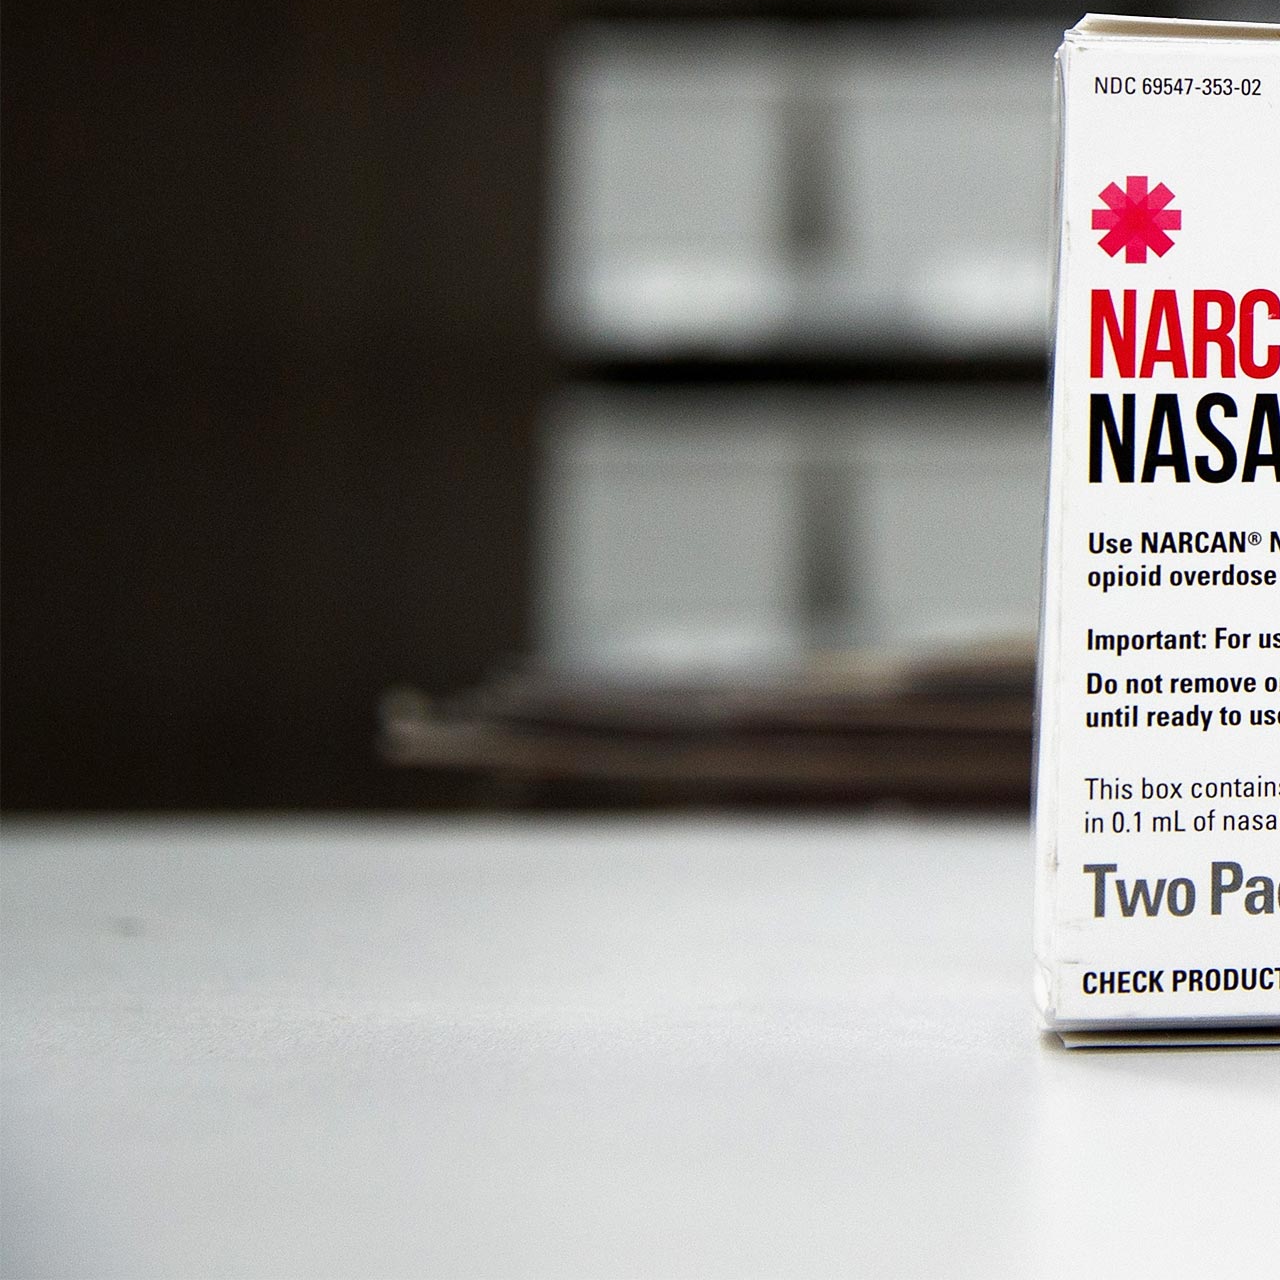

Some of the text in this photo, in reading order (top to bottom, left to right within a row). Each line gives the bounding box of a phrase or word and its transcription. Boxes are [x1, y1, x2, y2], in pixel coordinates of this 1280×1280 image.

[1095, 77, 1261, 96] NDC 69547-353-02
[1089, 532, 1132, 554] Use
[1088, 565, 1161, 593] opioid
[1170, 564, 1276, 586] overdose
[1087, 629, 1206, 656] Important:
[1215, 627, 1251, 649] For
[1087, 673, 1117, 695] Do
[1126, 675, 1163, 694] not
[1170, 677, 1256, 693] remove
[1086, 705, 1138, 728] until
[1147, 704, 1213, 732] ready
[1219, 707, 1241, 726] to
[1085, 778, 1132, 800] This
[1142, 777, 1182, 799] box
[1085, 812, 1103, 833] in
[1112, 811, 1140, 833] 0.1
[1153, 810, 1185, 832] mL
[1194, 809, 1215, 832] of
[1083, 864, 1195, 918] Two
[1082, 970, 1164, 995] CHECK
